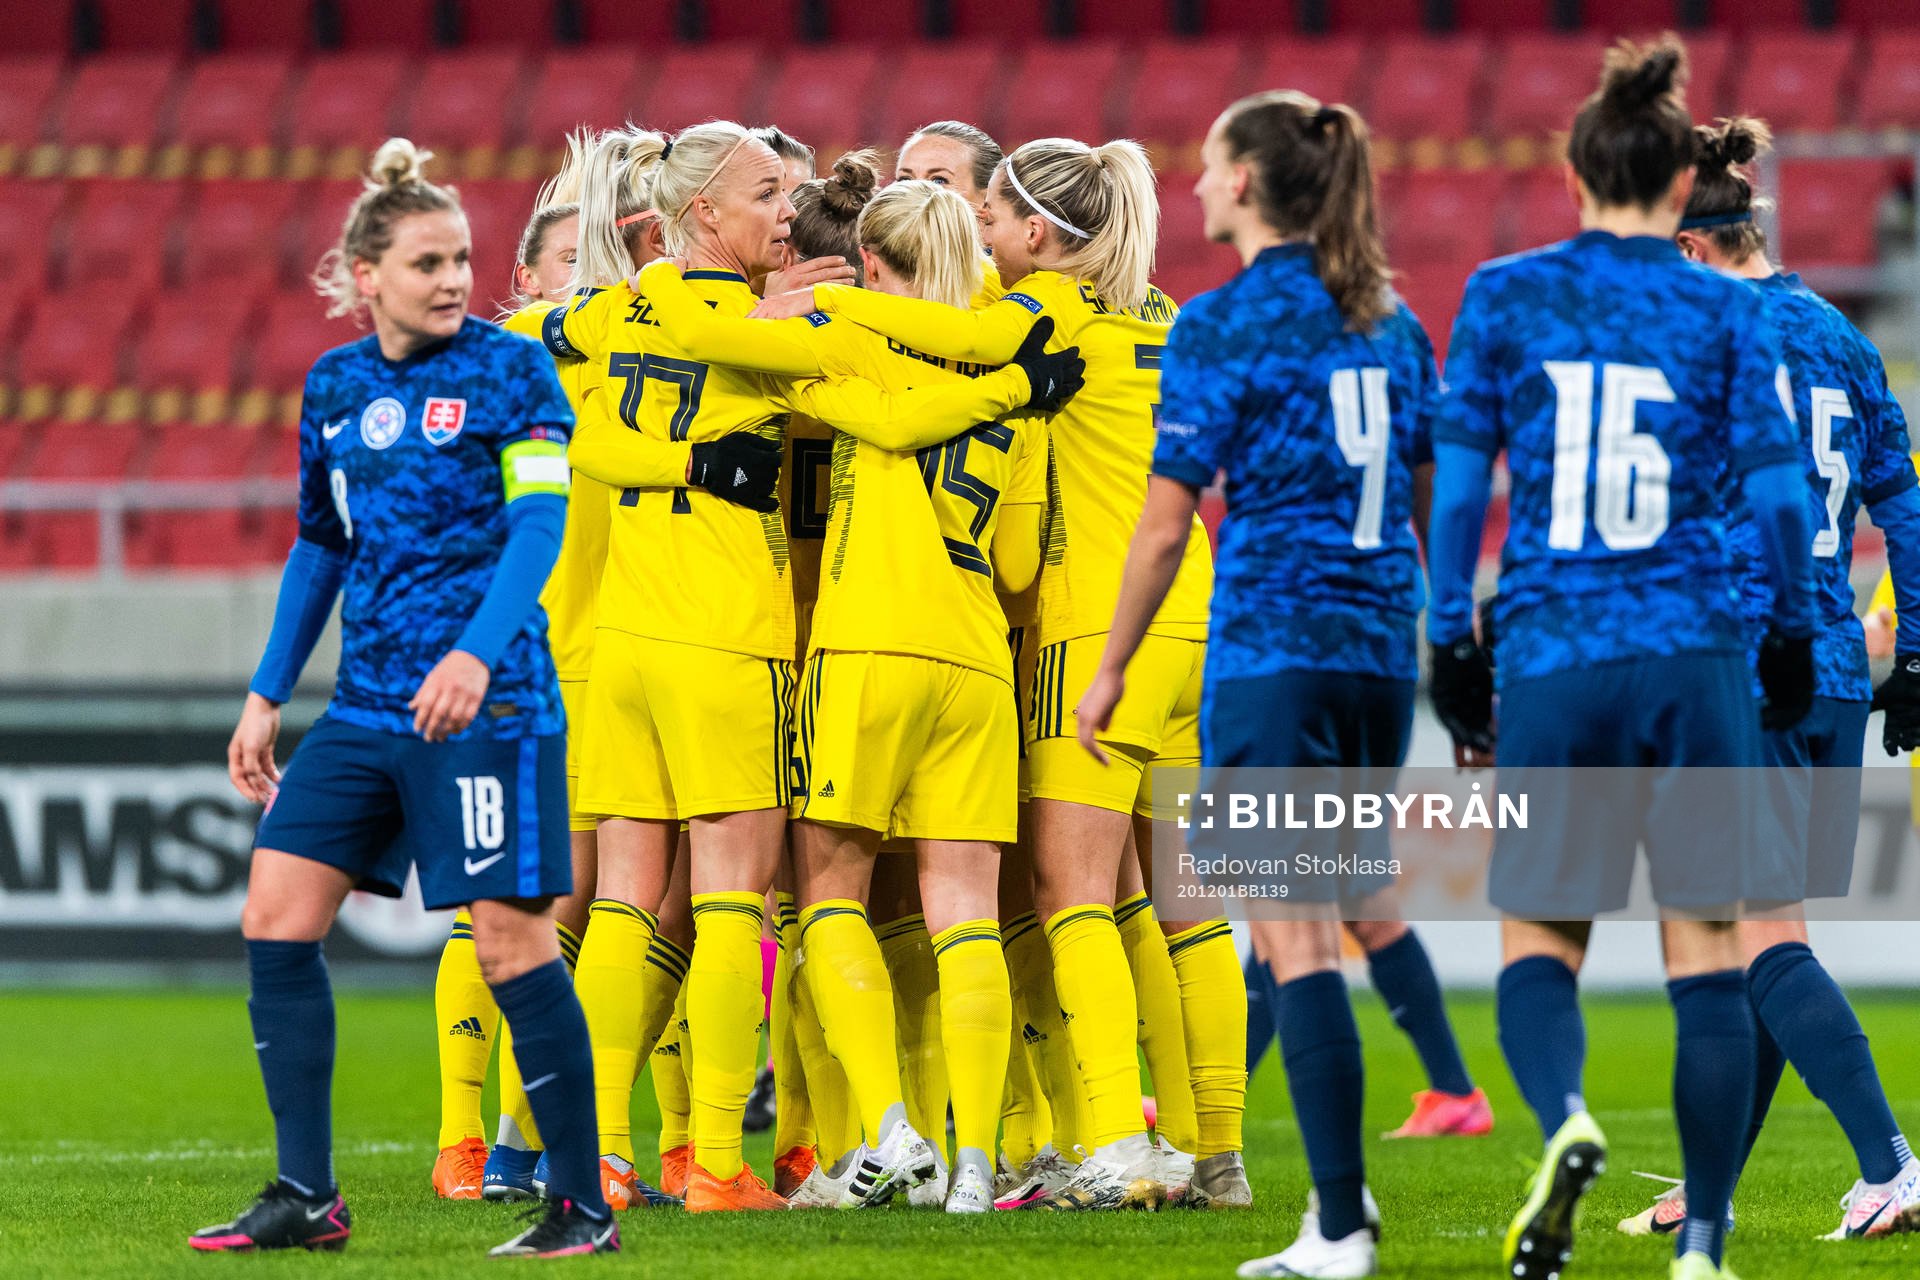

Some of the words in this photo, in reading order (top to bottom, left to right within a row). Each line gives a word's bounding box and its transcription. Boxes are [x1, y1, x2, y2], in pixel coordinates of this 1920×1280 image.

[1329, 367, 1390, 550] 4
[1542, 360, 1677, 551] 16
[455, 775, 505, 850] 18
[449, 1028, 487, 1041] adidas
[484, 1173, 503, 1182] OPA
[954, 1190, 979, 1202] COPA
